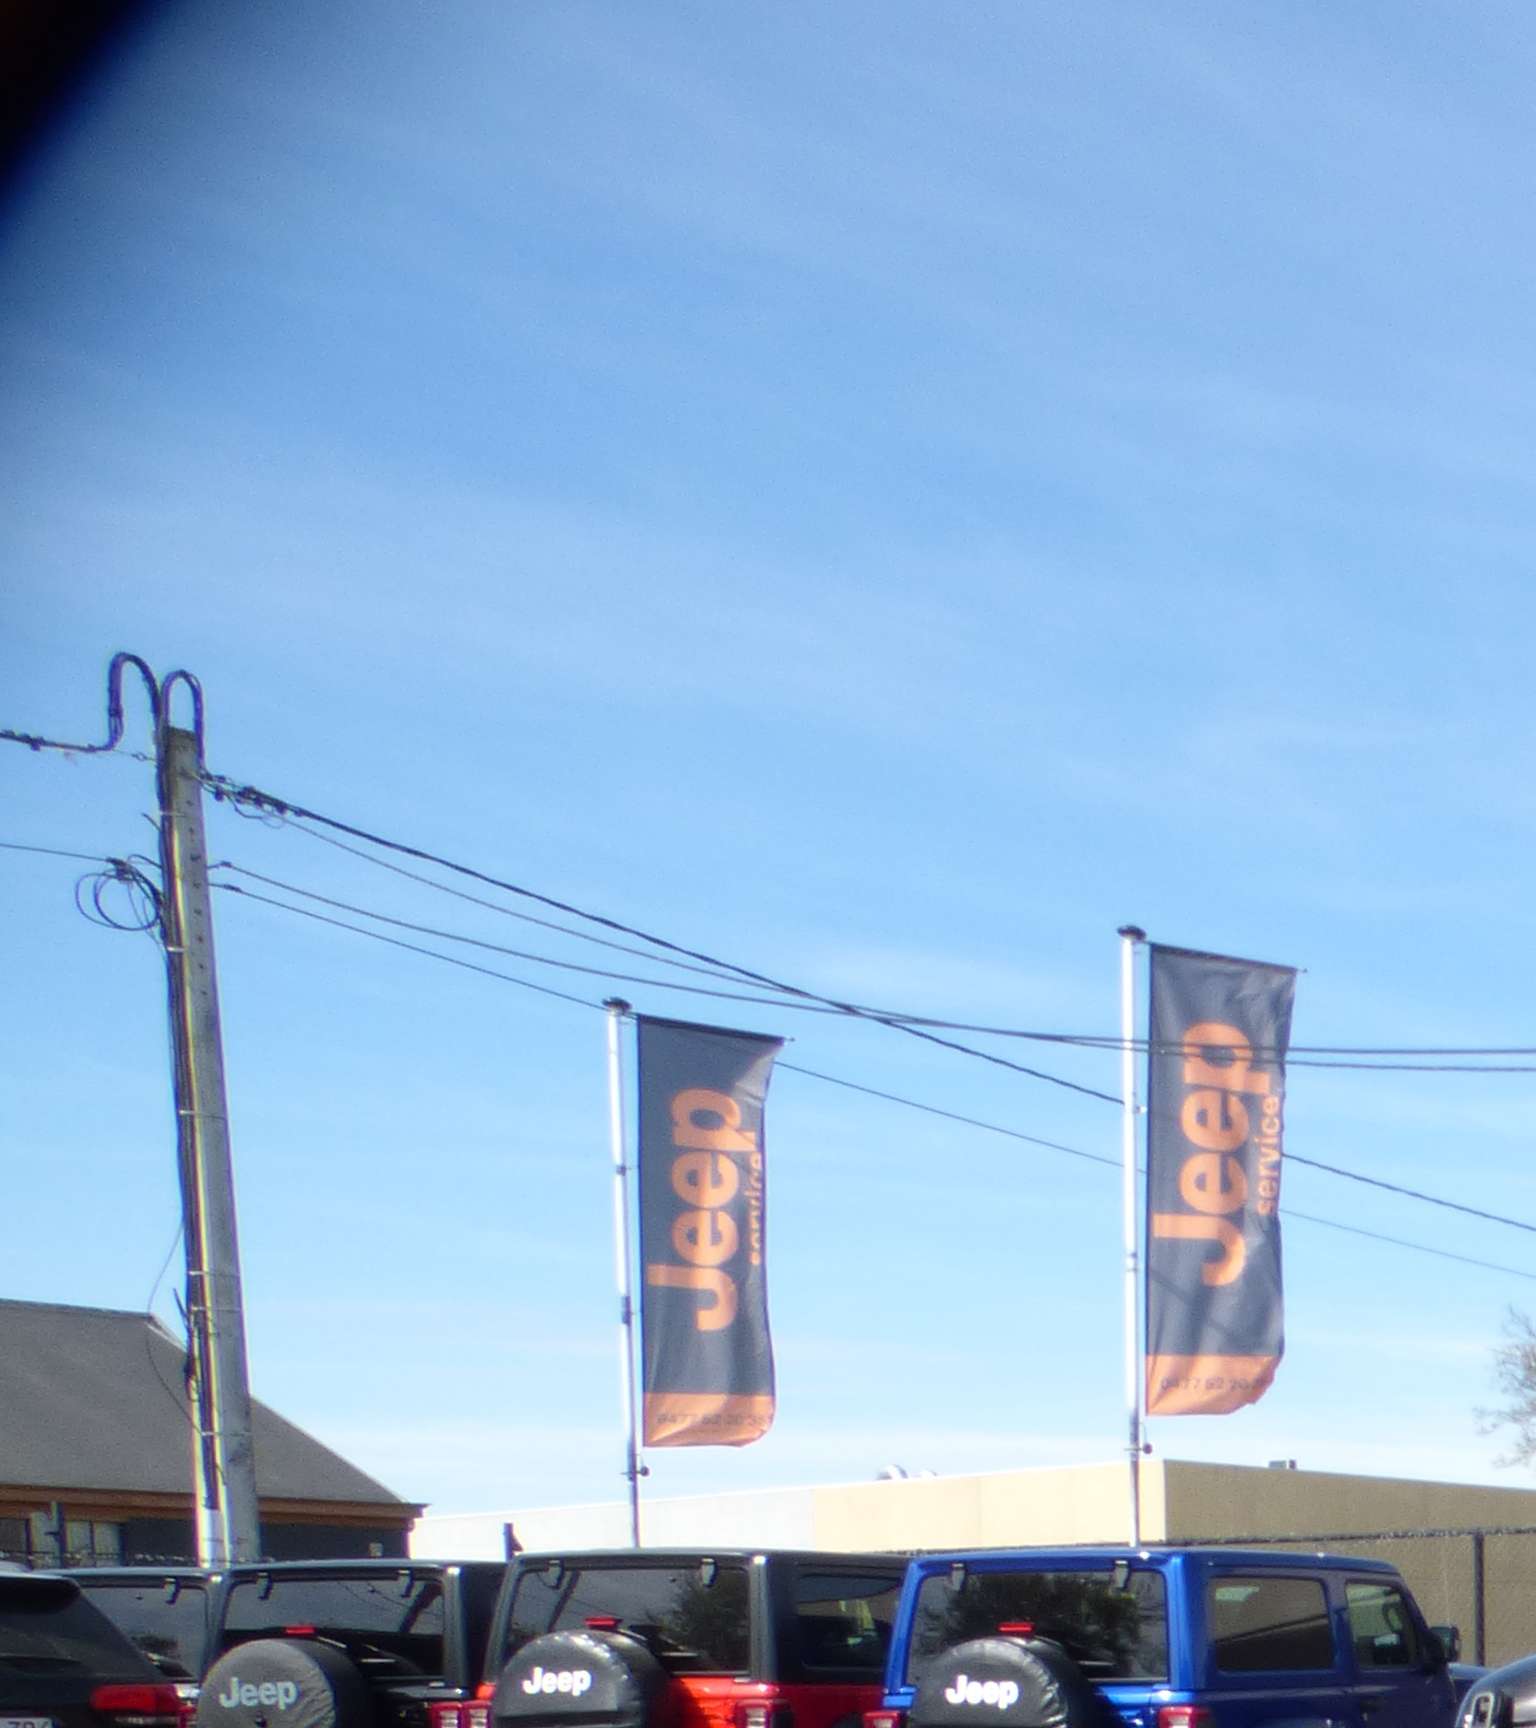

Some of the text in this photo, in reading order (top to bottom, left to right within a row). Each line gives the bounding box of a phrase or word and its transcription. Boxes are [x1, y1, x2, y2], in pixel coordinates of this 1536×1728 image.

[1152, 1021, 1270, 1287] Jeep
[1255, 1096, 1281, 1216] service
[647, 1087, 756, 1331] Jeep
[219, 1676, 299, 1710] Jeep
[521, 1666, 593, 1697] Jeep
[944, 1674, 1020, 1709] Jeep
